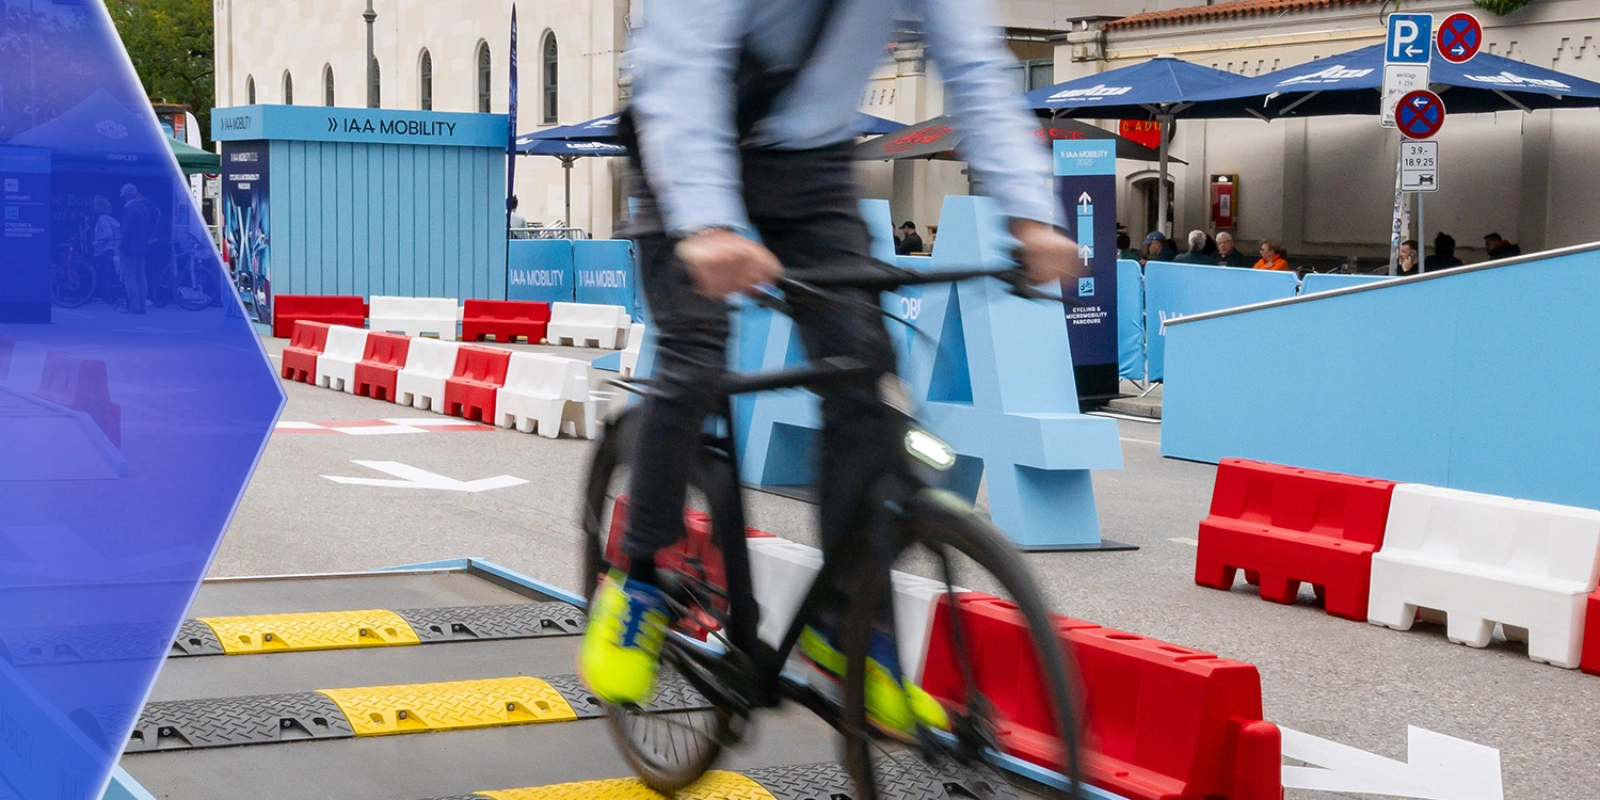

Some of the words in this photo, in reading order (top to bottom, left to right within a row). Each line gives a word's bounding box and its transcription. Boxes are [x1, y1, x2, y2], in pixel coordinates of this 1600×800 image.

[1393, 20, 1419, 57] P
[344, 118, 375, 134] IAA
[380, 119, 456, 136] MOBILITY
[1079, 150, 1108, 158] MOBILITY
[1405, 158, 1434, 167] 18.9.25
[510, 269, 526, 285] IAA
[526, 270, 564, 287] MOBILITY
[595, 270, 627, 288] MOBILITY
[1066, 311, 1107, 319] MICROMOBILITY
